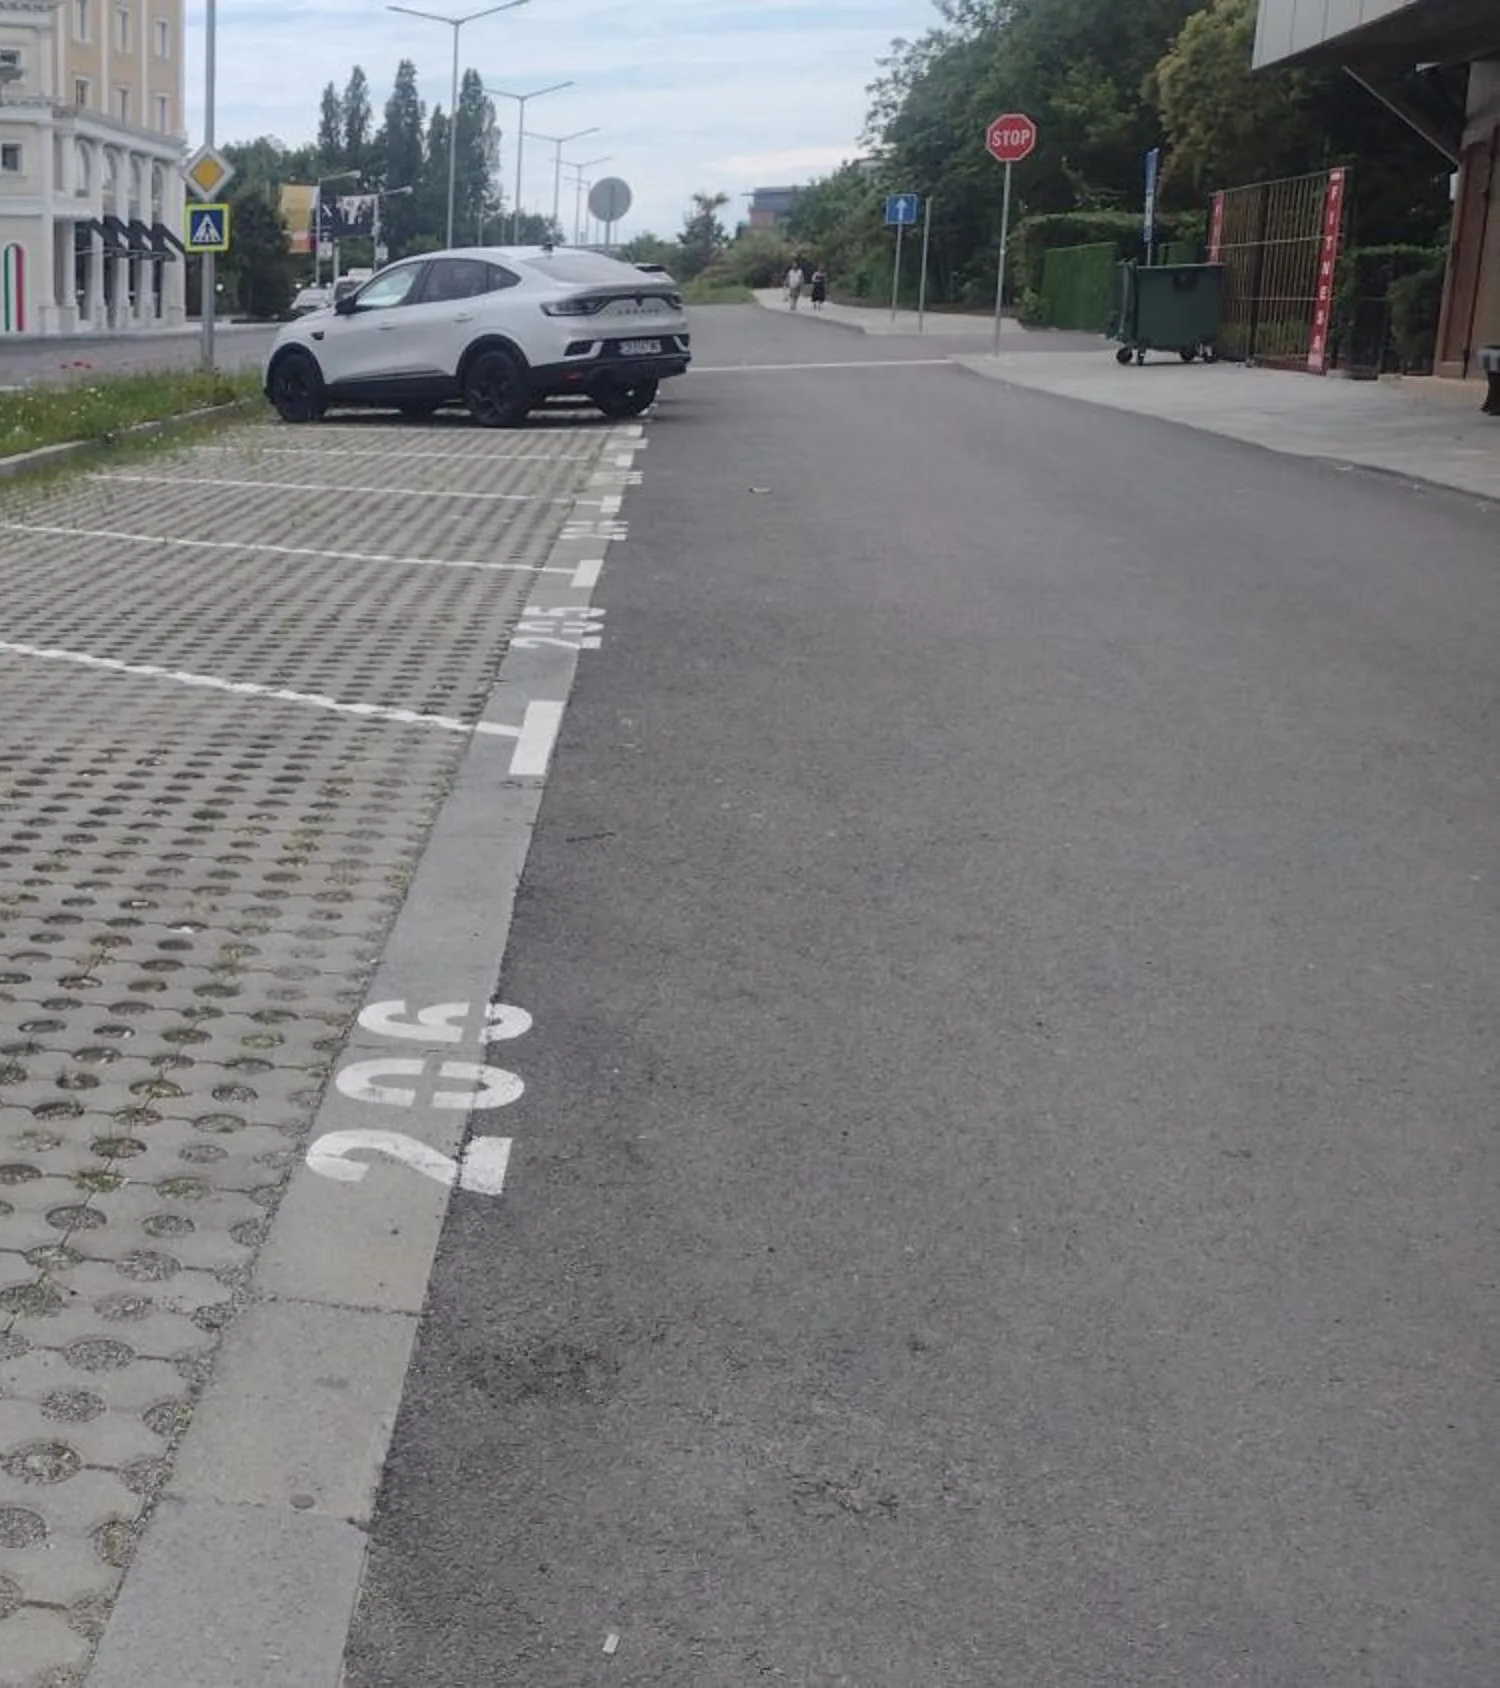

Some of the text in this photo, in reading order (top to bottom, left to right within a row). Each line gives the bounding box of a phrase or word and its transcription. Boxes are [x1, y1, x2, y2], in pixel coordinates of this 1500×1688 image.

[991, 129, 1031, 147] STOP
[509, 606, 606, 650] 205
[306, 1000, 533, 1194] 206
